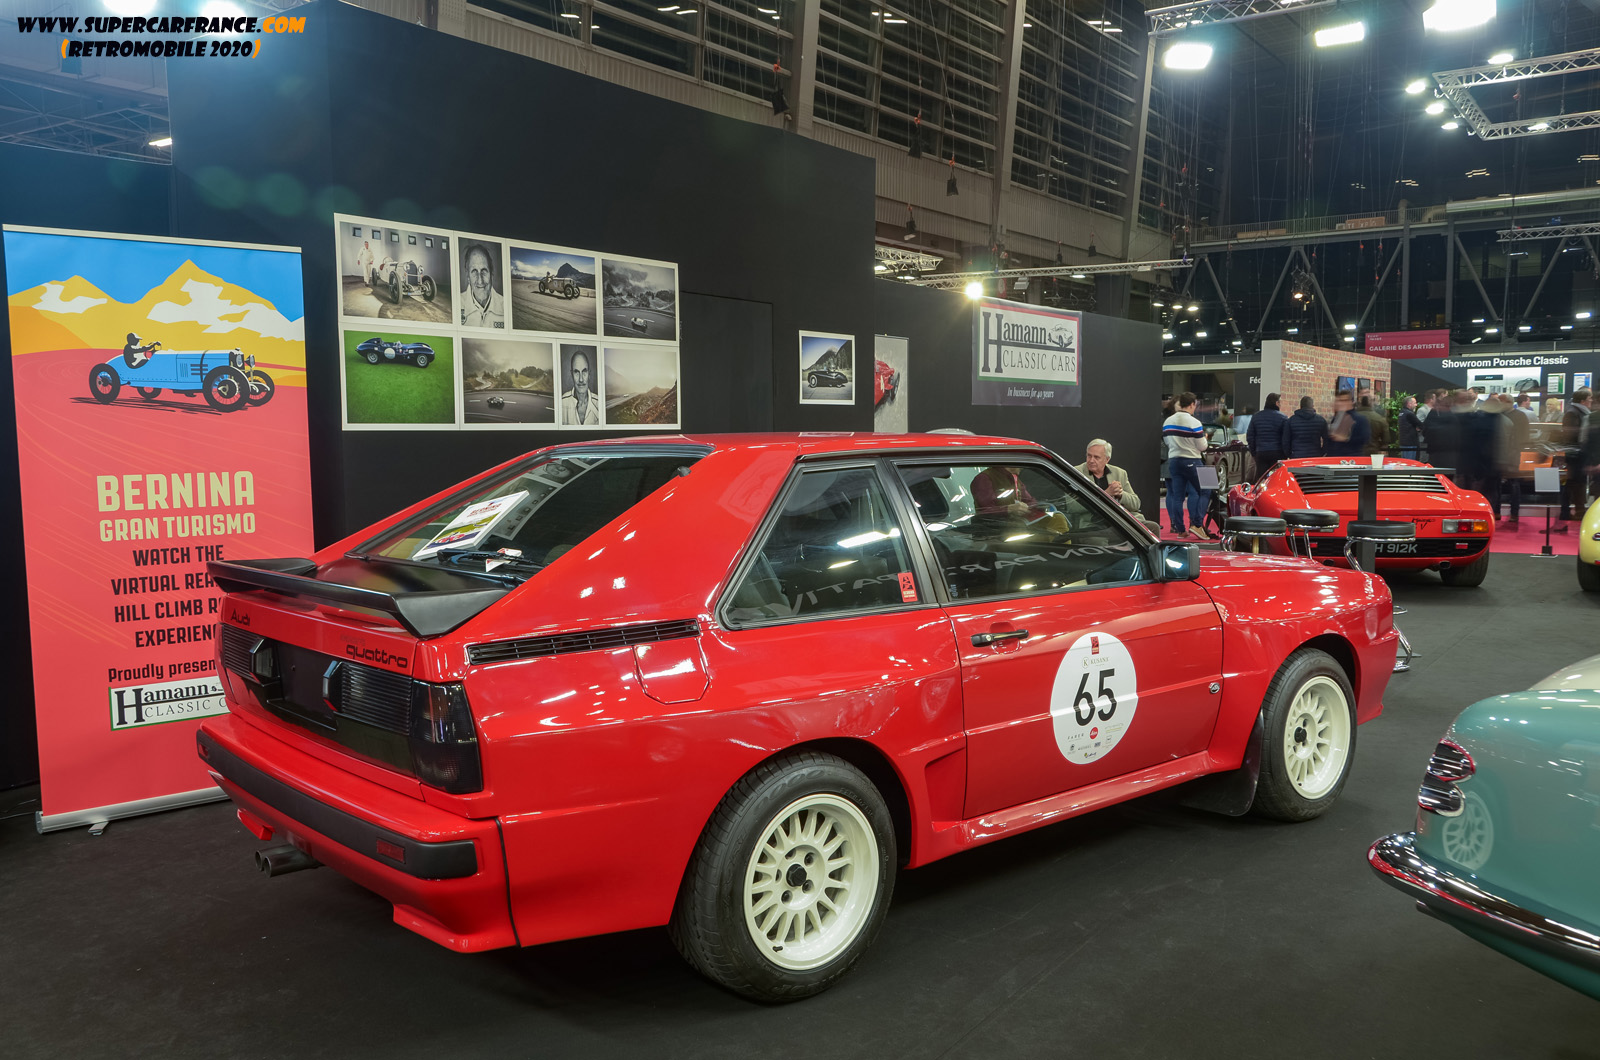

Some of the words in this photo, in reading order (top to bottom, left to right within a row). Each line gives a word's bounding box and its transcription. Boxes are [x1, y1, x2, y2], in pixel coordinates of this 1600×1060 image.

[981, 311, 1047, 374] Hamann
[1369, 344, 1397, 352] GALERIE
[1002, 349, 1047, 371] CLASSIC
[1051, 354, 1076, 373] CARS
[1285, 361, 1315, 374] PORSCHE
[1441, 358, 1491, 369] Showroom
[1492, 356, 1532, 367] Porsche
[1532, 355, 1569, 366] Classic
[97, 470, 255, 513] BERNINA
[99, 517, 160, 542] GRAN
[162, 512, 256, 539] TURISMO
[132, 546, 191, 567] WATCH
[195, 544, 225, 563] THE
[1386, 543, 1418, 554] 912K
[111, 574, 180, 596] VIRTUAL
[184, 571, 217, 591] REA
[114, 603, 151, 623] HILL
[155, 598, 204, 620] CLIMB
[208, 597, 221, 614] R
[346, 644, 408, 669] quattro
[108, 663, 164, 683] Proudly
[114, 683, 210, 726] Hamann
[144, 698, 211, 719] CLASSIC
[1073, 668, 1117, 727] 65
